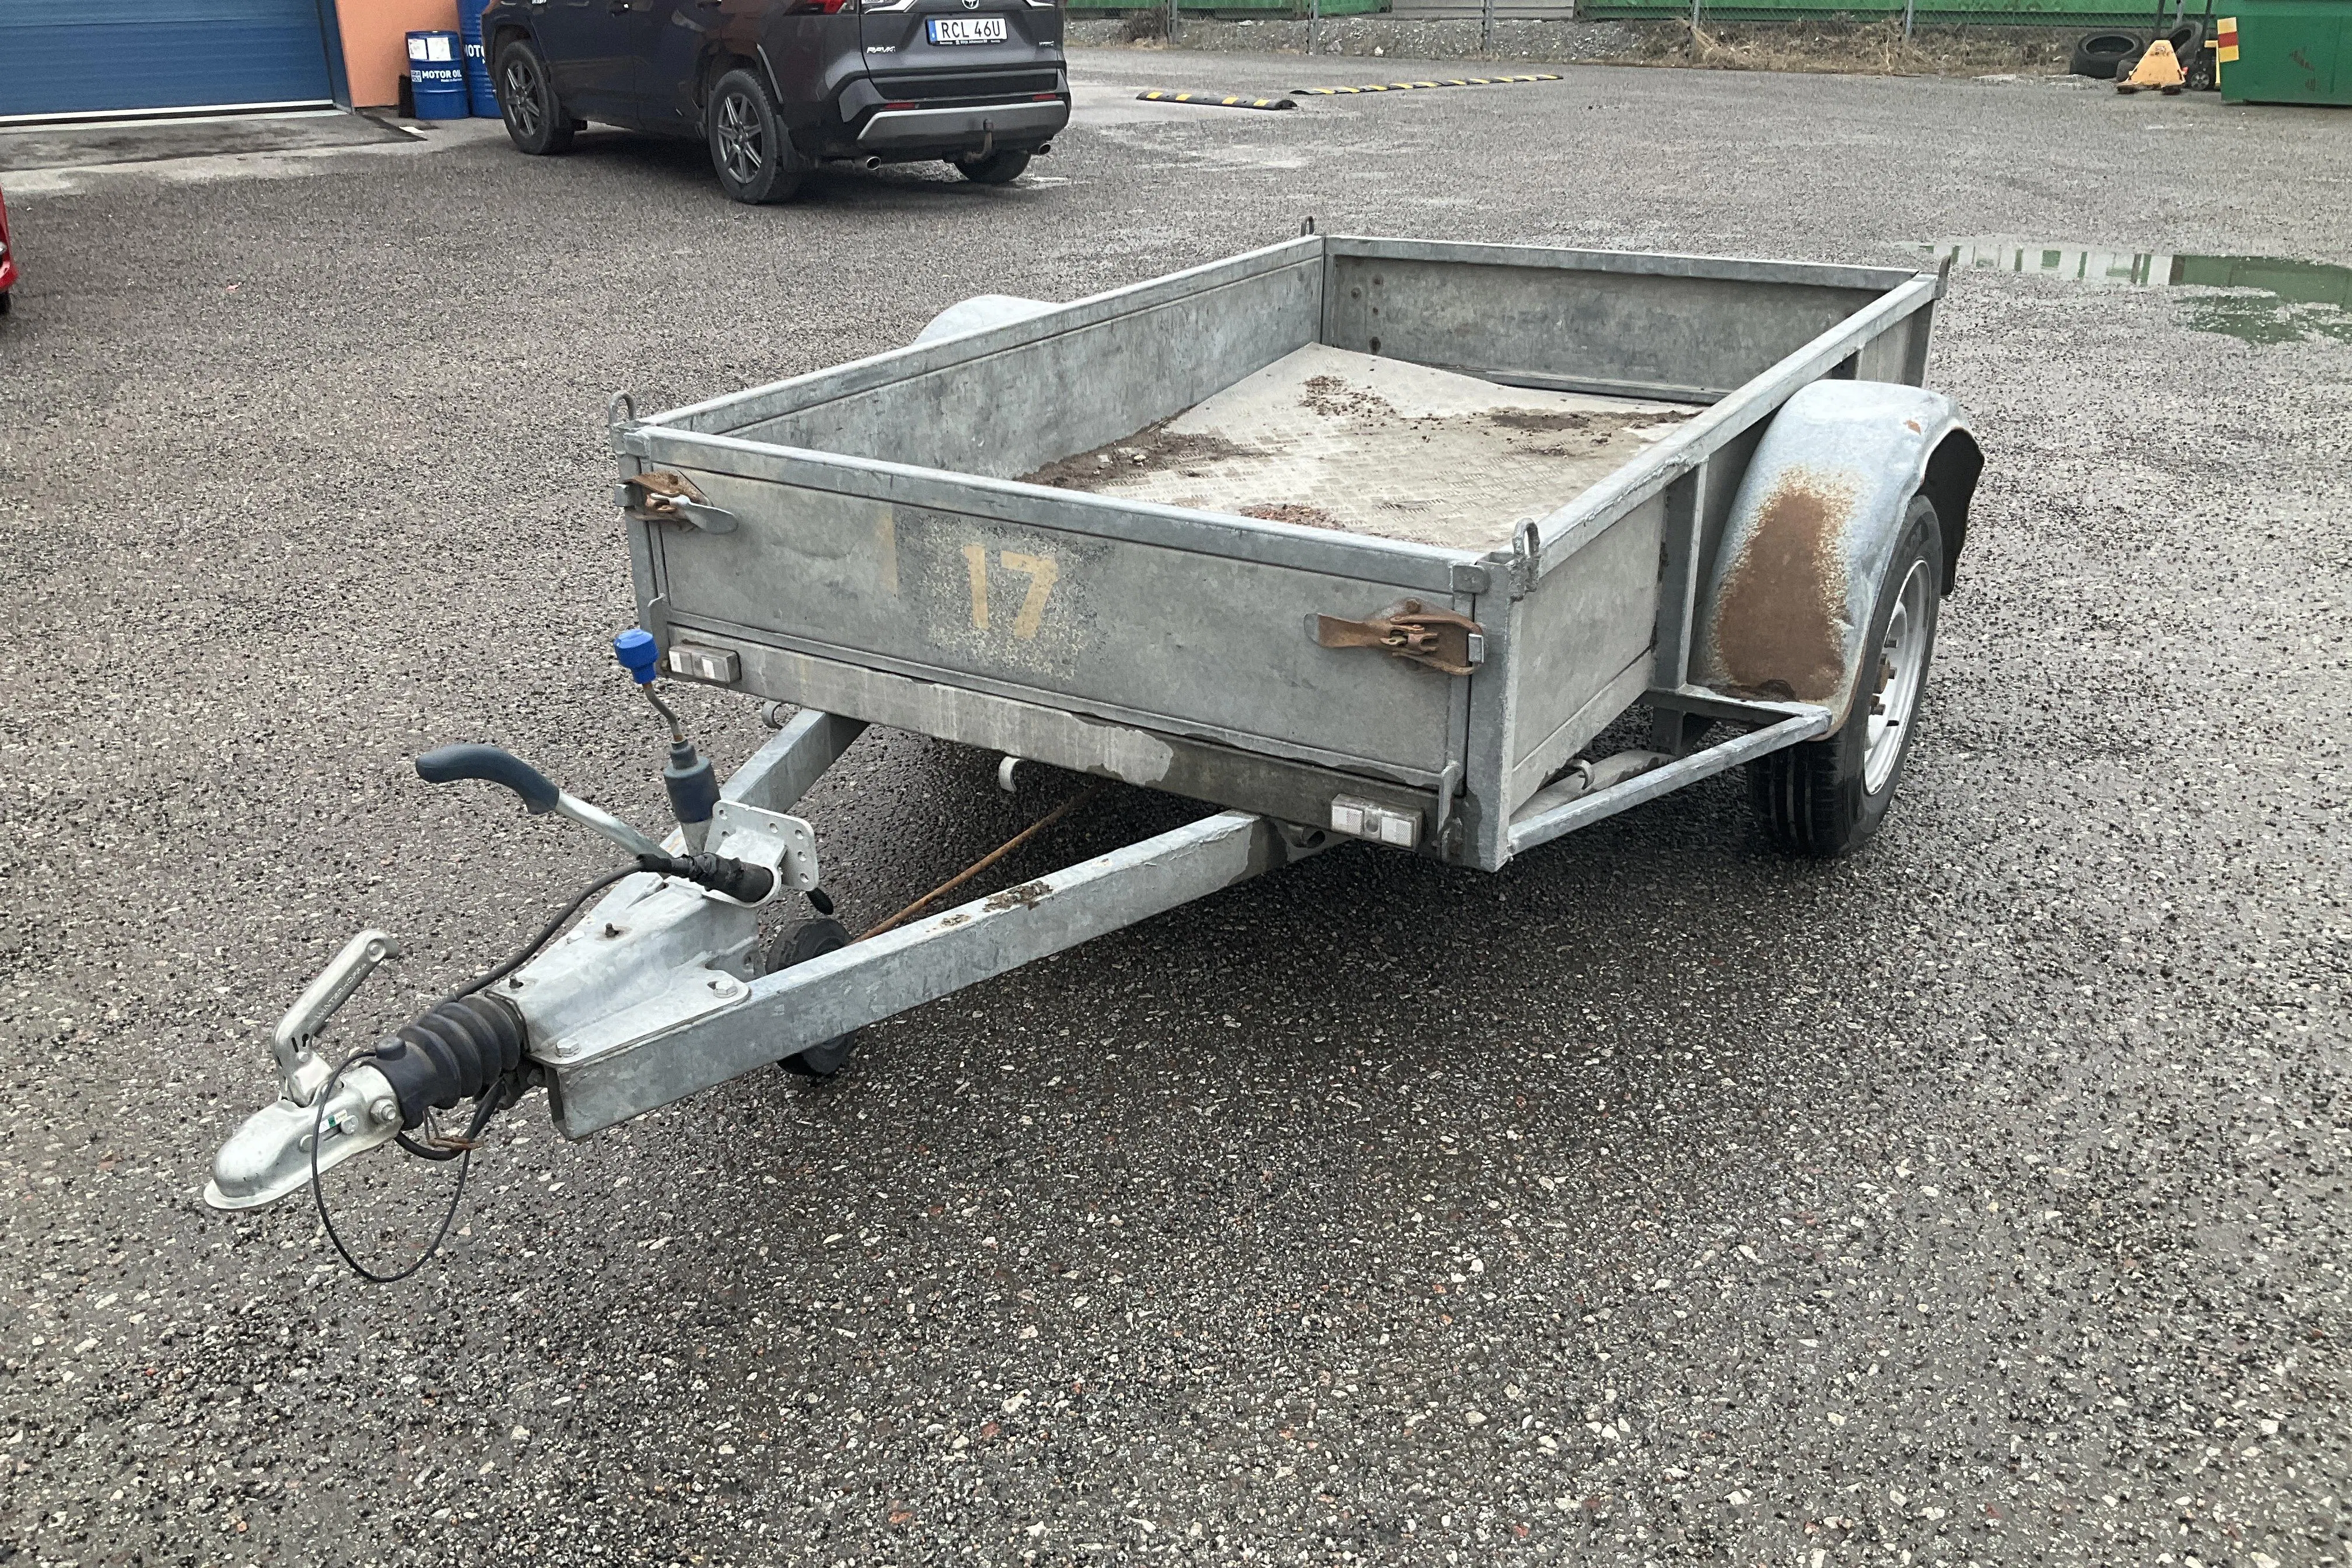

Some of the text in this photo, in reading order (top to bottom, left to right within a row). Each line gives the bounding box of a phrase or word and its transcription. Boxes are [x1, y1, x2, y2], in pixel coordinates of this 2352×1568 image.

[941, 20, 1000, 38] RCL 46U
[422, 69, 462, 79] MOTOR OIL
[963, 544, 1059, 640] 17
